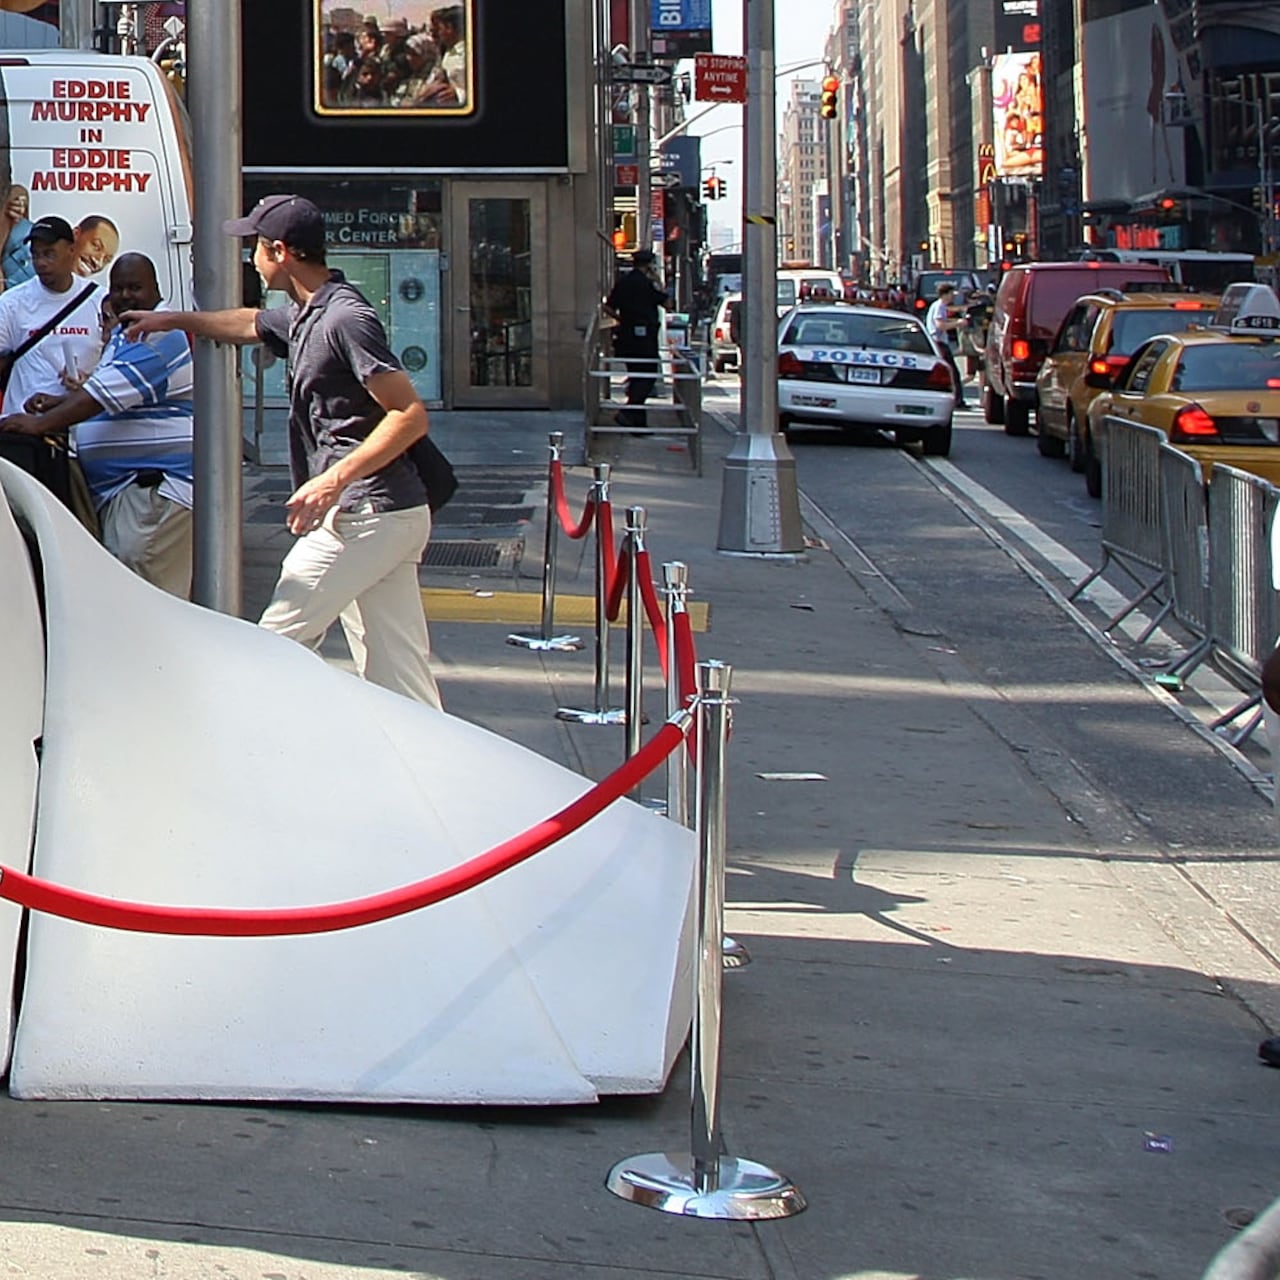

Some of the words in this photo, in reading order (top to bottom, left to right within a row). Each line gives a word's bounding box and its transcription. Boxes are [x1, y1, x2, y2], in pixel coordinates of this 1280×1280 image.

[698, 57, 708, 68] NO
[703, 72, 739, 83] ANYTIME
[52, 80, 130, 99] EDDIE
[31, 100, 152, 122] MURPHY
[80, 128, 103, 143] IN
[52, 148, 131, 169] EDDIE
[31, 171, 153, 192] MURPHY
[321, 210, 354, 224] MED
[340, 226, 398, 243] CENTER
[60, 327, 90, 336] DAVE
[811, 350, 918, 368] POLICE
